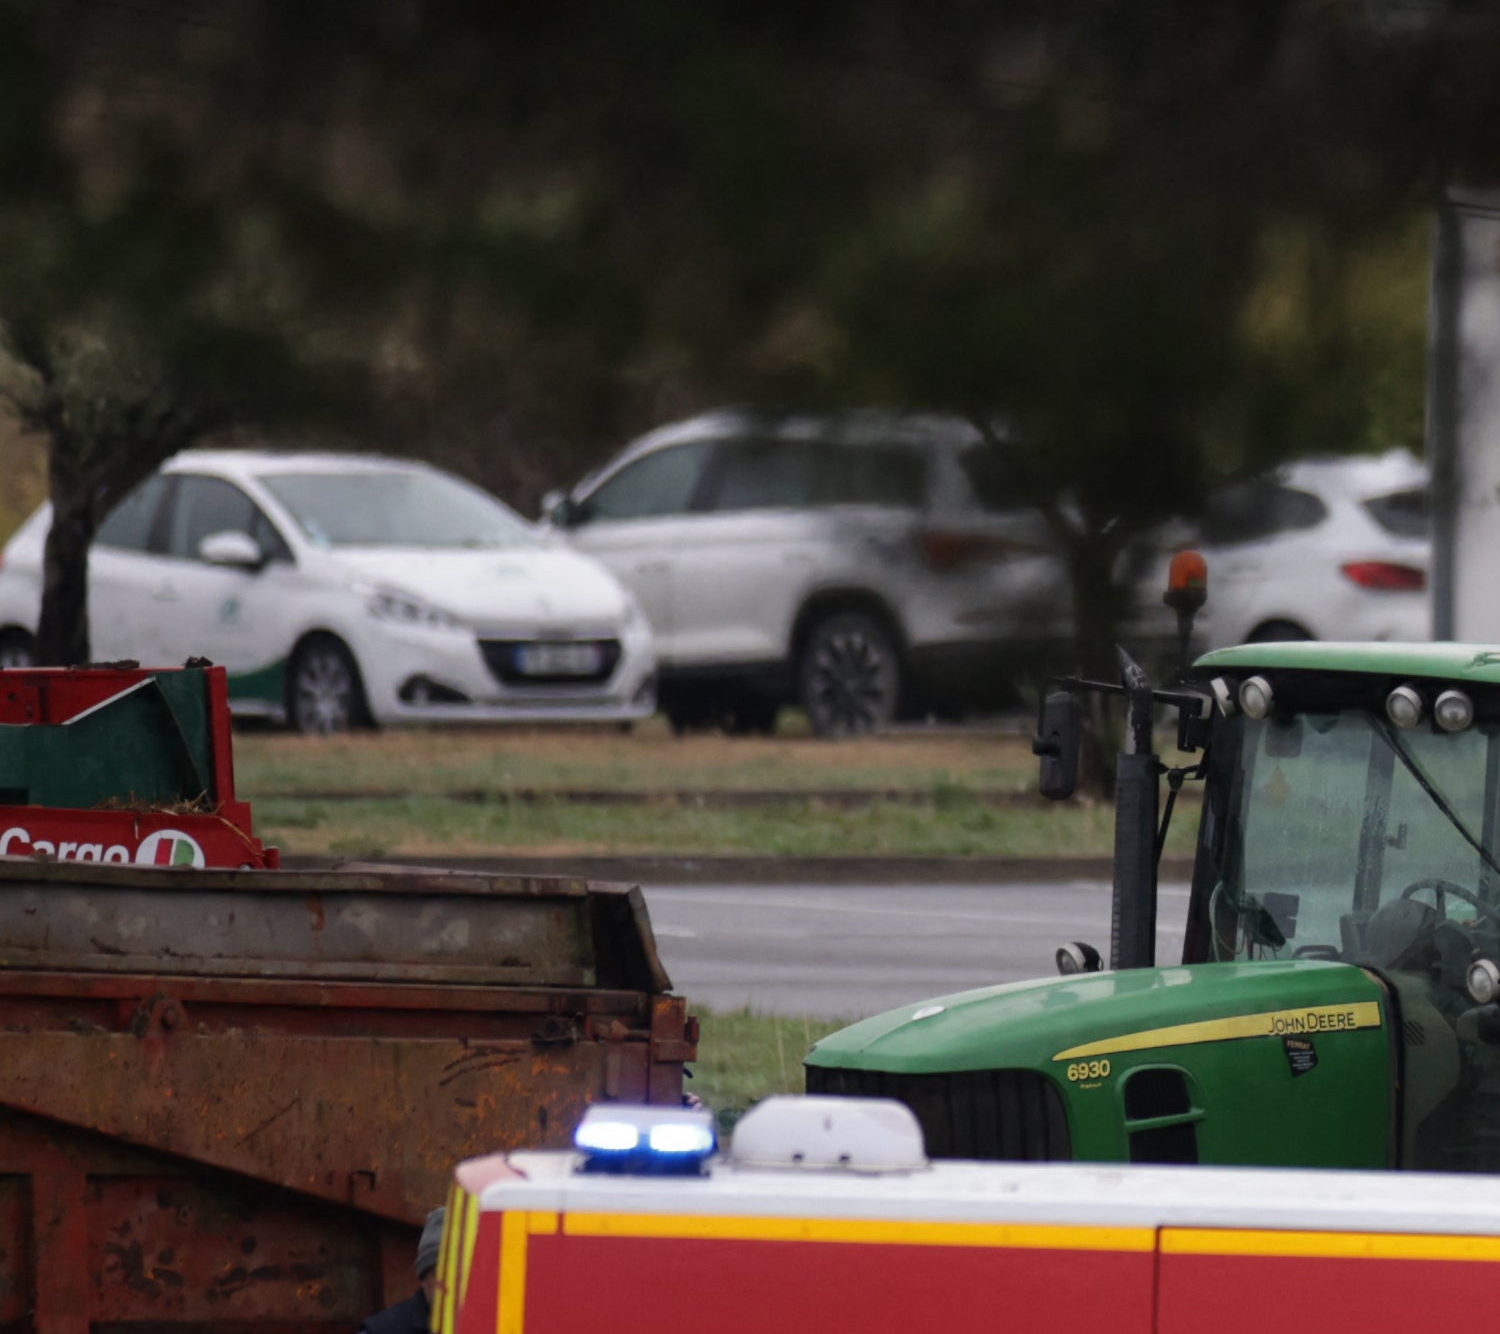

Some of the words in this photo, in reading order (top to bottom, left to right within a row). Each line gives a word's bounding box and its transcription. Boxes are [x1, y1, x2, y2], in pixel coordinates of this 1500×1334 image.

[1268, 1016, 1305, 1033] JOHN
[1307, 1012, 1356, 1030] DEERE
[1067, 1059, 1111, 1082] 6930
